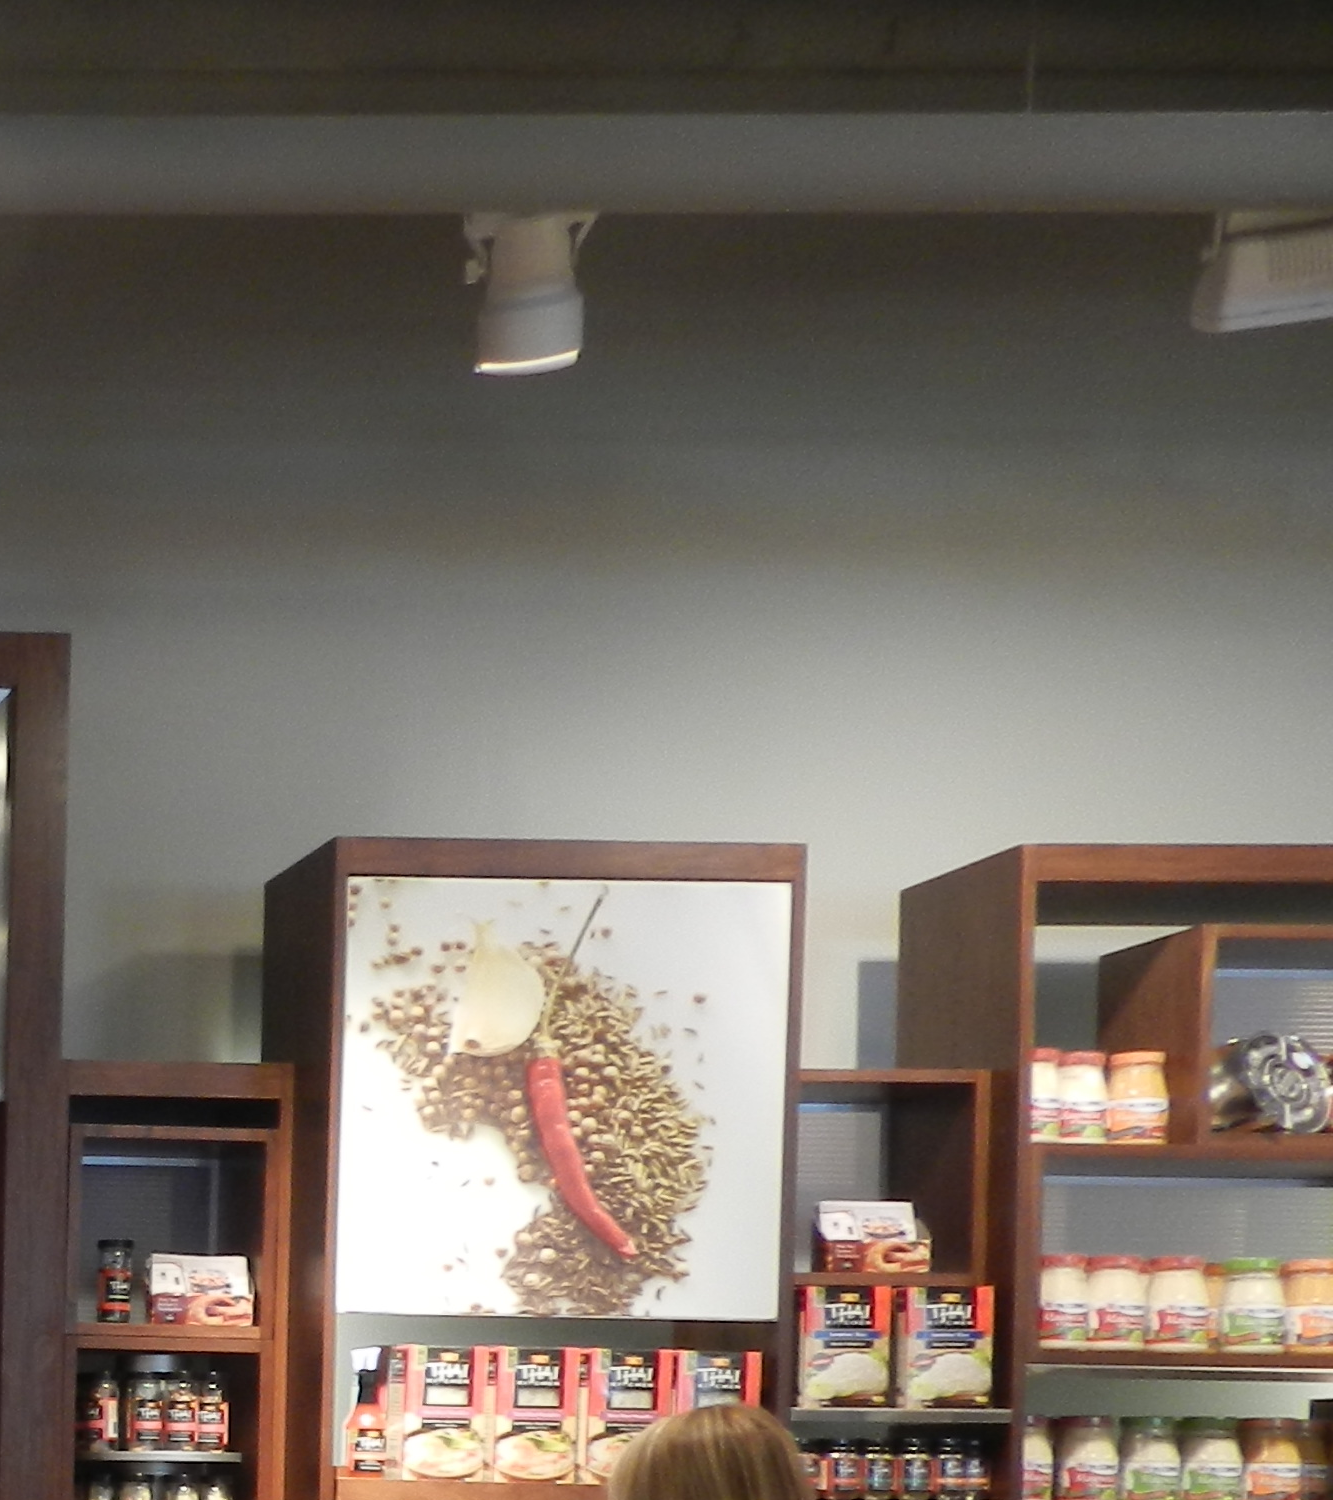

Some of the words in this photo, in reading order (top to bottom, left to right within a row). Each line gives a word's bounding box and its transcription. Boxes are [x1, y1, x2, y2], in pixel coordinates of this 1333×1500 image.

[825, 1303, 871, 1321] THAI
[927, 1303, 972, 1321] THAI
[427, 1362, 469, 1382] THAI
[516, 1364, 560, 1384] THAI
[609, 1366, 654, 1385] THAI
[697, 1367, 741, 1386] THAI
